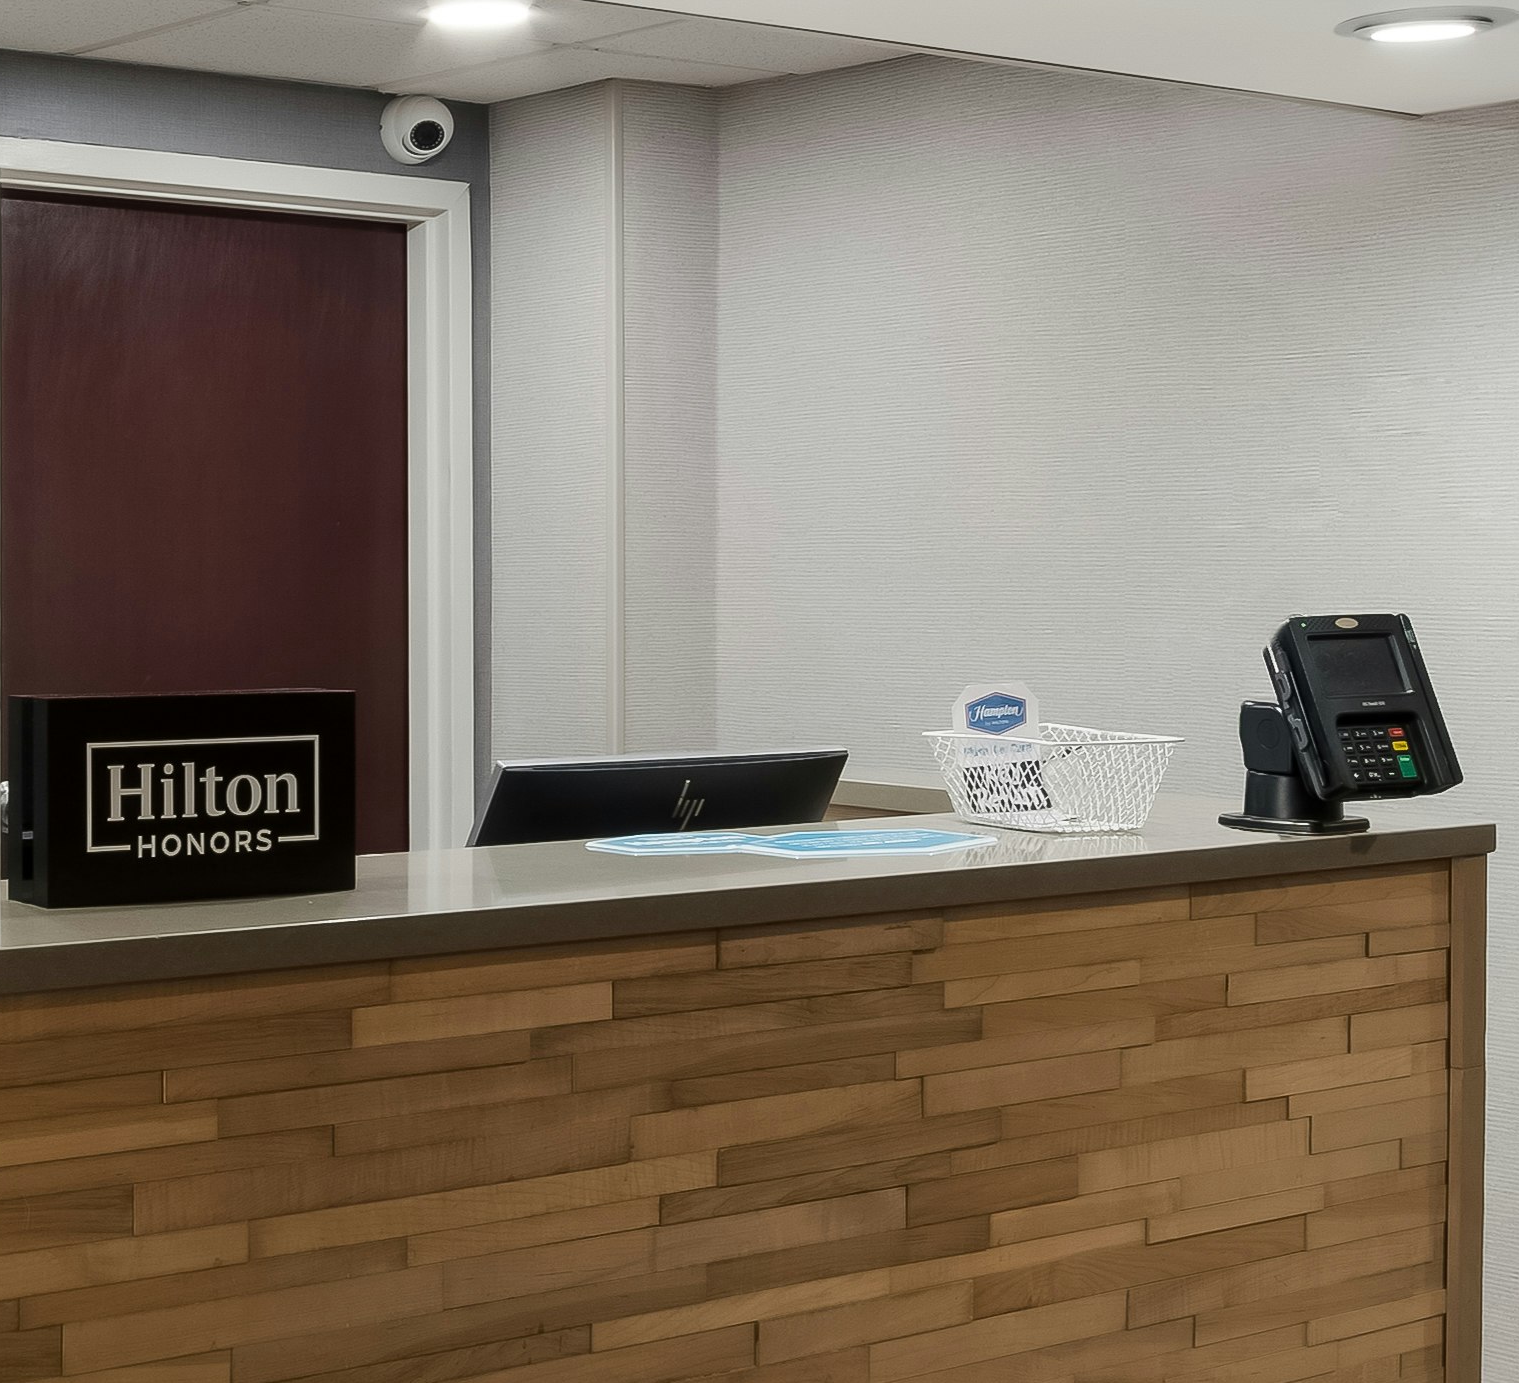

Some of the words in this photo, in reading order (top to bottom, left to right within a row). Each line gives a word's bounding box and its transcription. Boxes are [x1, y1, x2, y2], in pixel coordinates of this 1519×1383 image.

[968, 704, 1024, 723] Hampton
[107, 762, 300, 821] Hilton
[137, 828, 272, 858] HONORS
